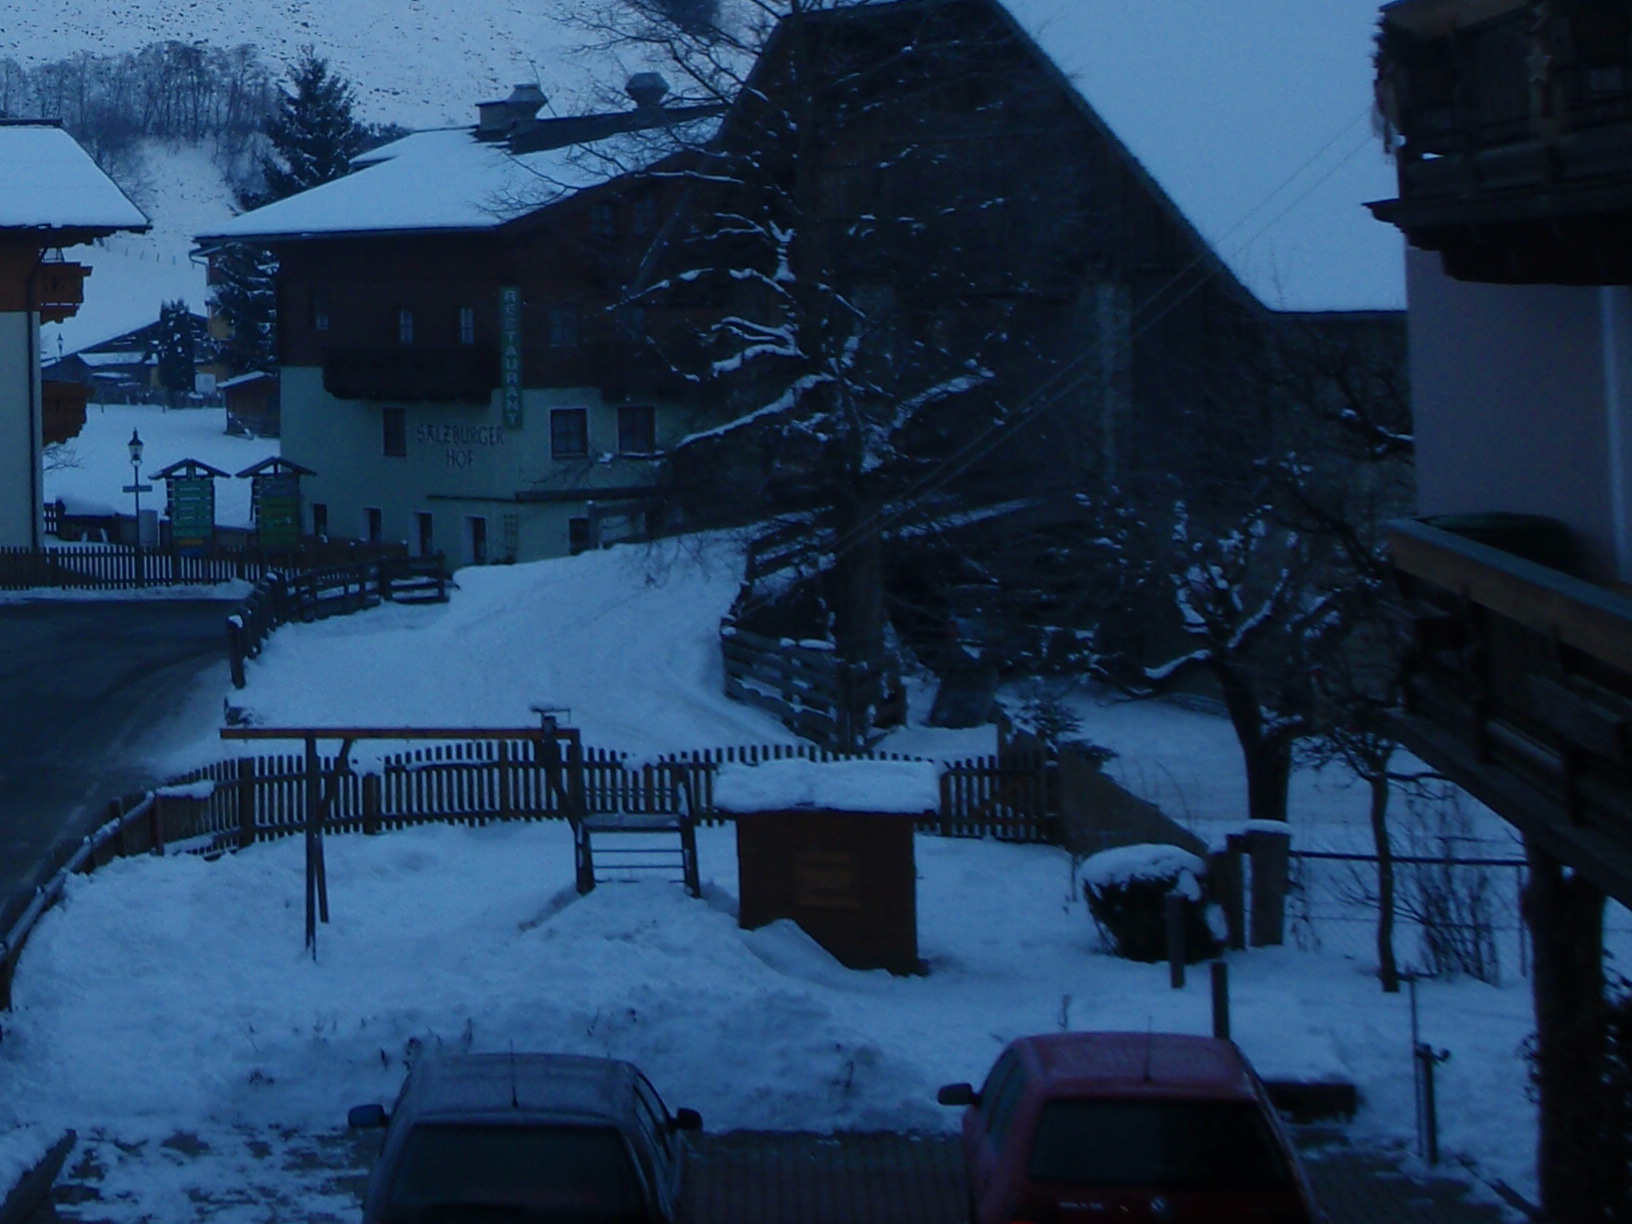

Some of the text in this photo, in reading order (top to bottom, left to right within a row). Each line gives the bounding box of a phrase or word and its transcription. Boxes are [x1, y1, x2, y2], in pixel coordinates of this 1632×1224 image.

[504, 289, 519, 424] RESTAURANT
[416, 423, 505, 445] SALZBURGER
[446, 449, 475, 468] HOF
